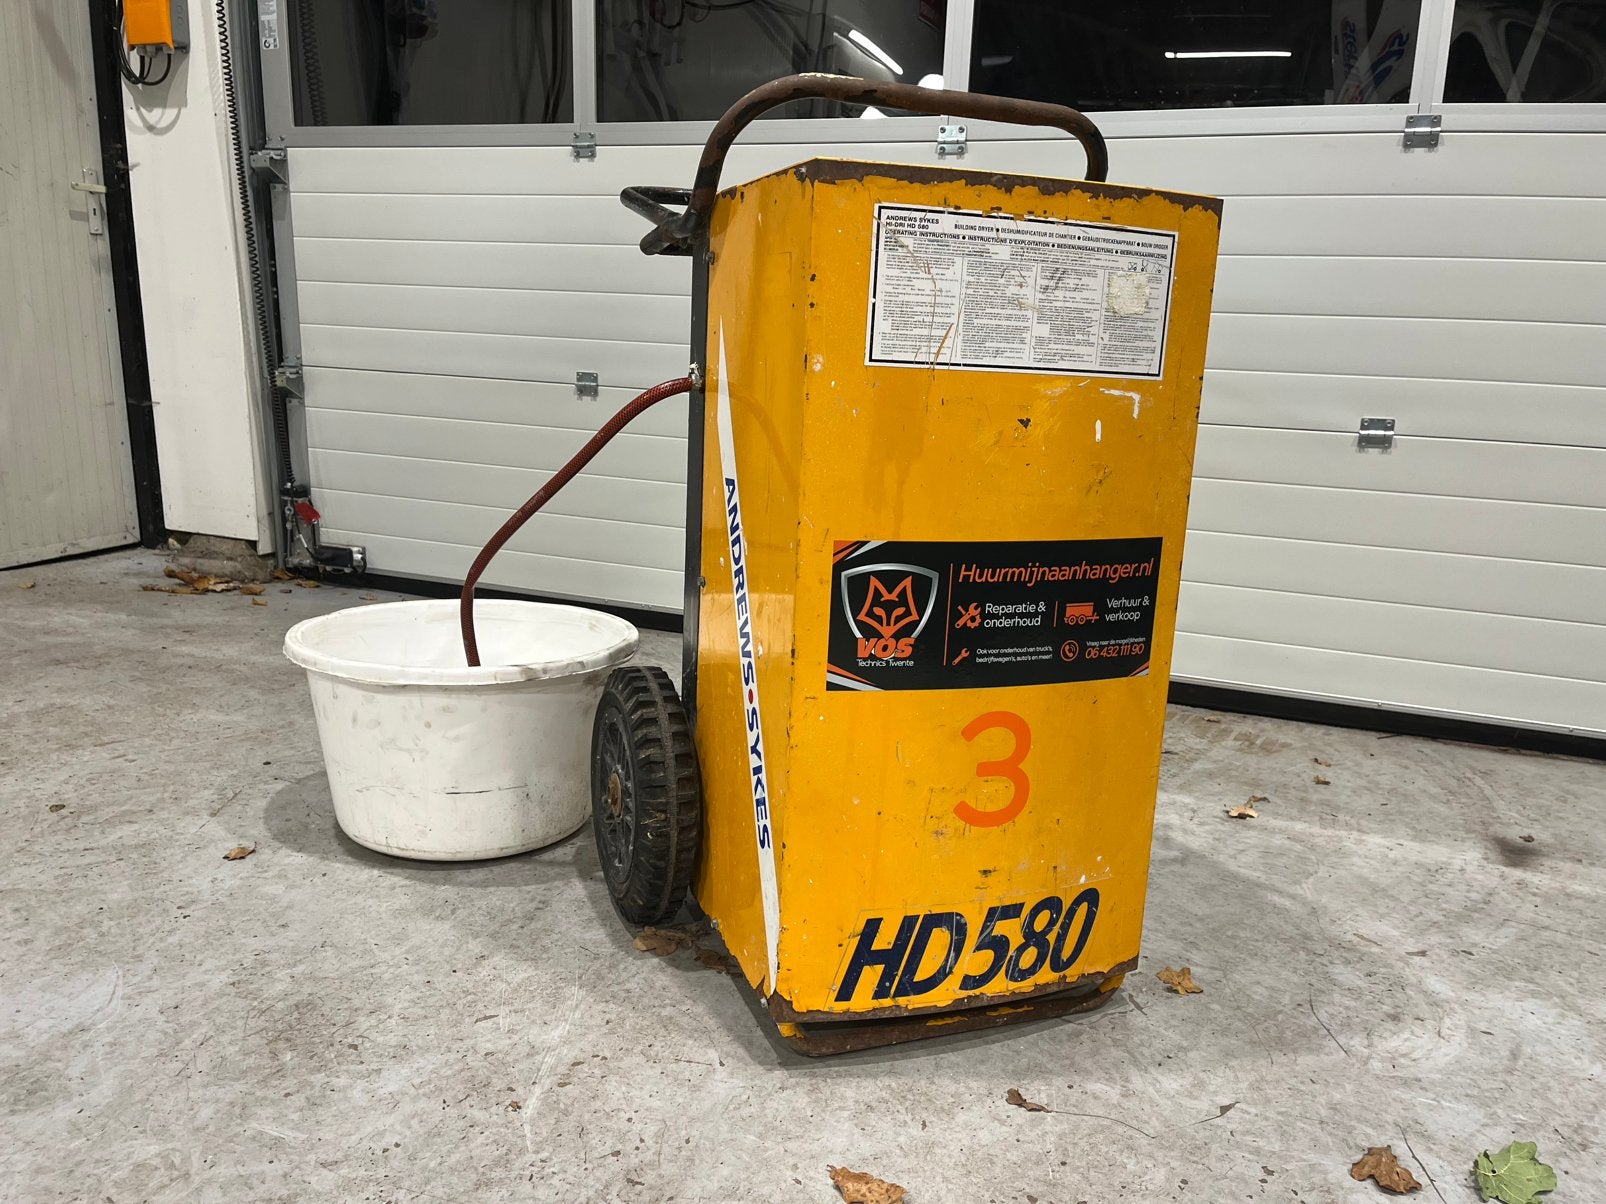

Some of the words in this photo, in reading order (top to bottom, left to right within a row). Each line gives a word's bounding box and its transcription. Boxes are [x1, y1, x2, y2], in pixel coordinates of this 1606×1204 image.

[918, 231, 960, 240] INSTRUCTIONS
[968, 236, 1008, 244] INSTRUCTIONS
[1008, 238, 1050, 248] D'EXPLOITATION
[958, 557, 1155, 587] Huurmijnaanhanger.nl
[984, 602, 1036, 616] Reparatie
[1037, 601, 1046, 613] &
[1106, 597, 1142, 608] Verhuur
[1142, 595, 1150, 606] &
[984, 615, 1041, 628] onderhoud
[1104, 610, 1141, 622] verkoop
[856, 637, 916, 658] VOS
[1085, 647, 1100, 659] 06
[1100, 645, 1120, 658] 432
[1120, 644, 1131, 656] 111
[1131, 643, 1145, 655] 90
[724, 477, 755, 687] ANDREWS
[746, 705, 771, 850] SYKES
[856, 658, 886, 667] Technics
[888, 658, 914, 667] Twente
[953, 710, 1032, 828] 3
